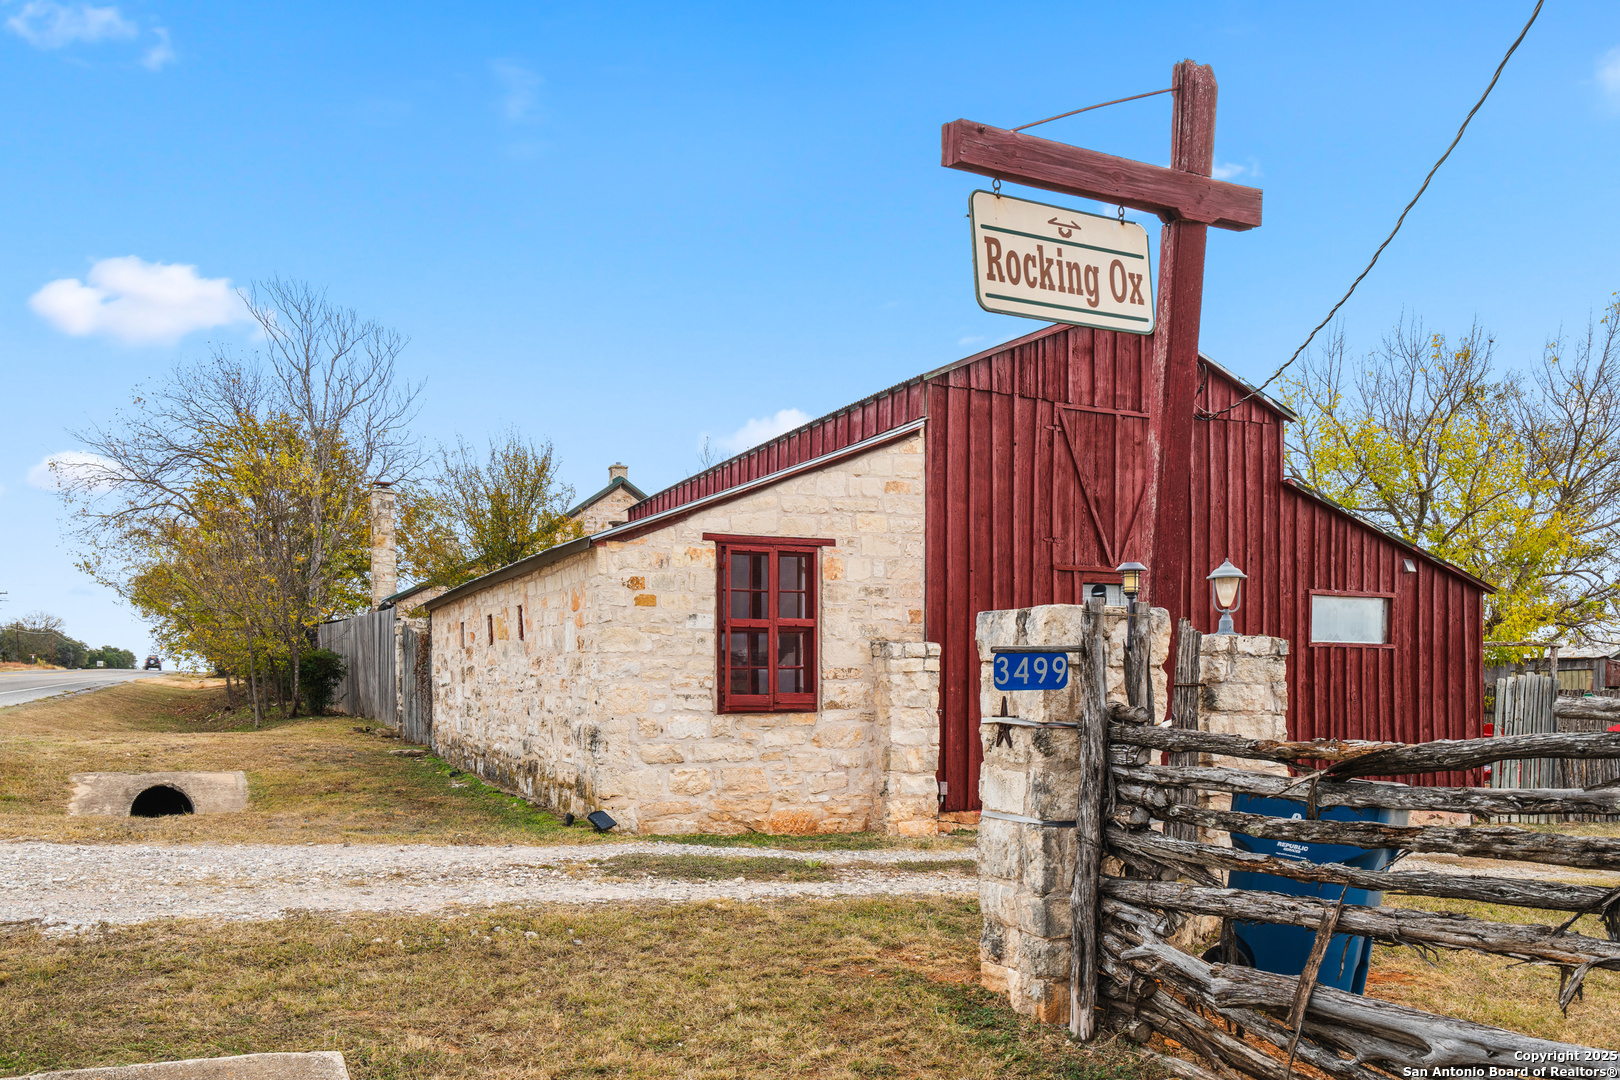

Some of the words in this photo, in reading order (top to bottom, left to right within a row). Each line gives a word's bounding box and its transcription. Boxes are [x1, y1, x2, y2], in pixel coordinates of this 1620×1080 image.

[984, 236, 1099, 308] Rocking
[1109, 259, 1145, 305] Ox
[995, 656, 1067, 685] 3499
